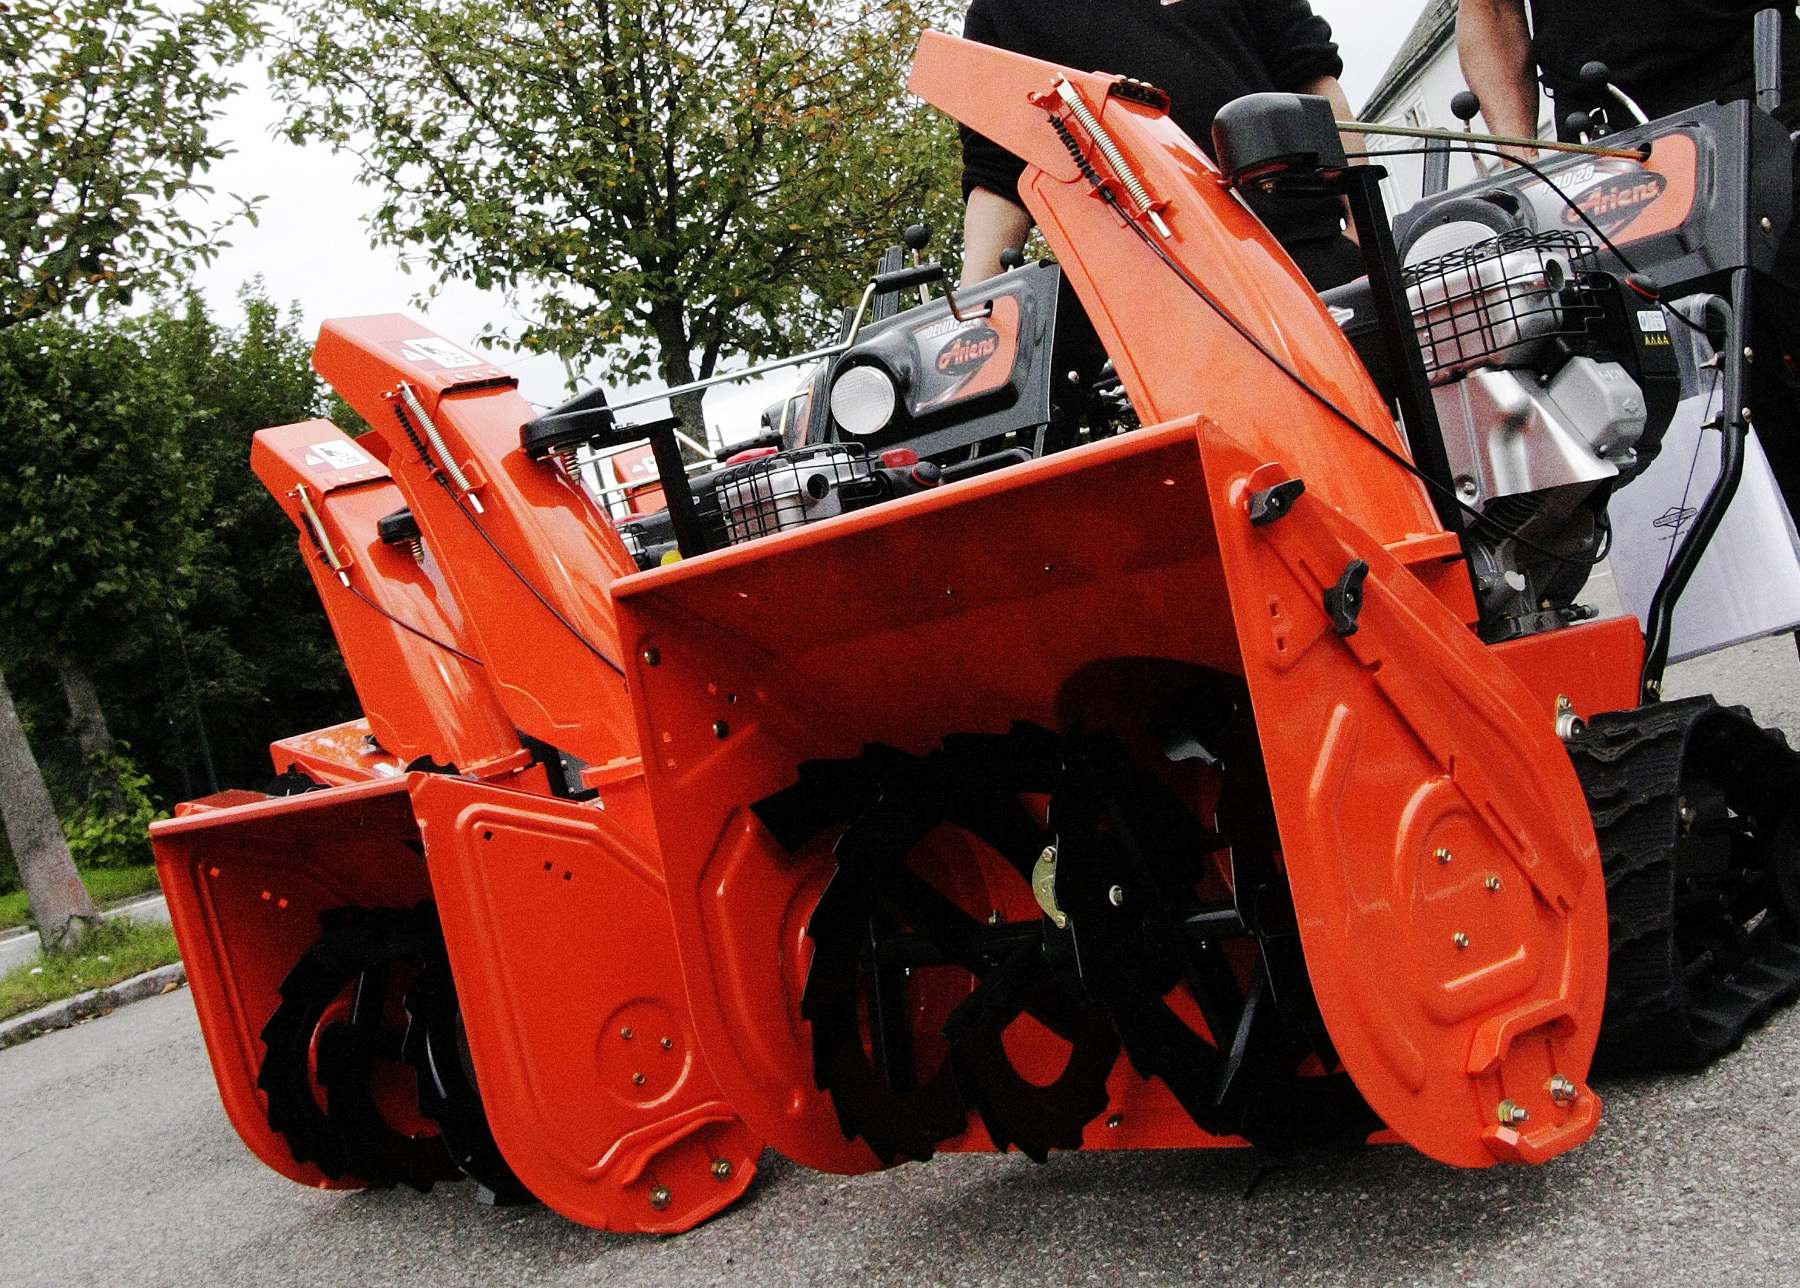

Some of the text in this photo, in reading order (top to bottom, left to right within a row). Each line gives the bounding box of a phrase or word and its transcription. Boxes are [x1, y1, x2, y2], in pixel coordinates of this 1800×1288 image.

[1574, 164, 1595, 184] 28
[1566, 179, 1660, 223] Ariens
[926, 318, 959, 339] DELUXE
[937, 337, 997, 370] Ariens
